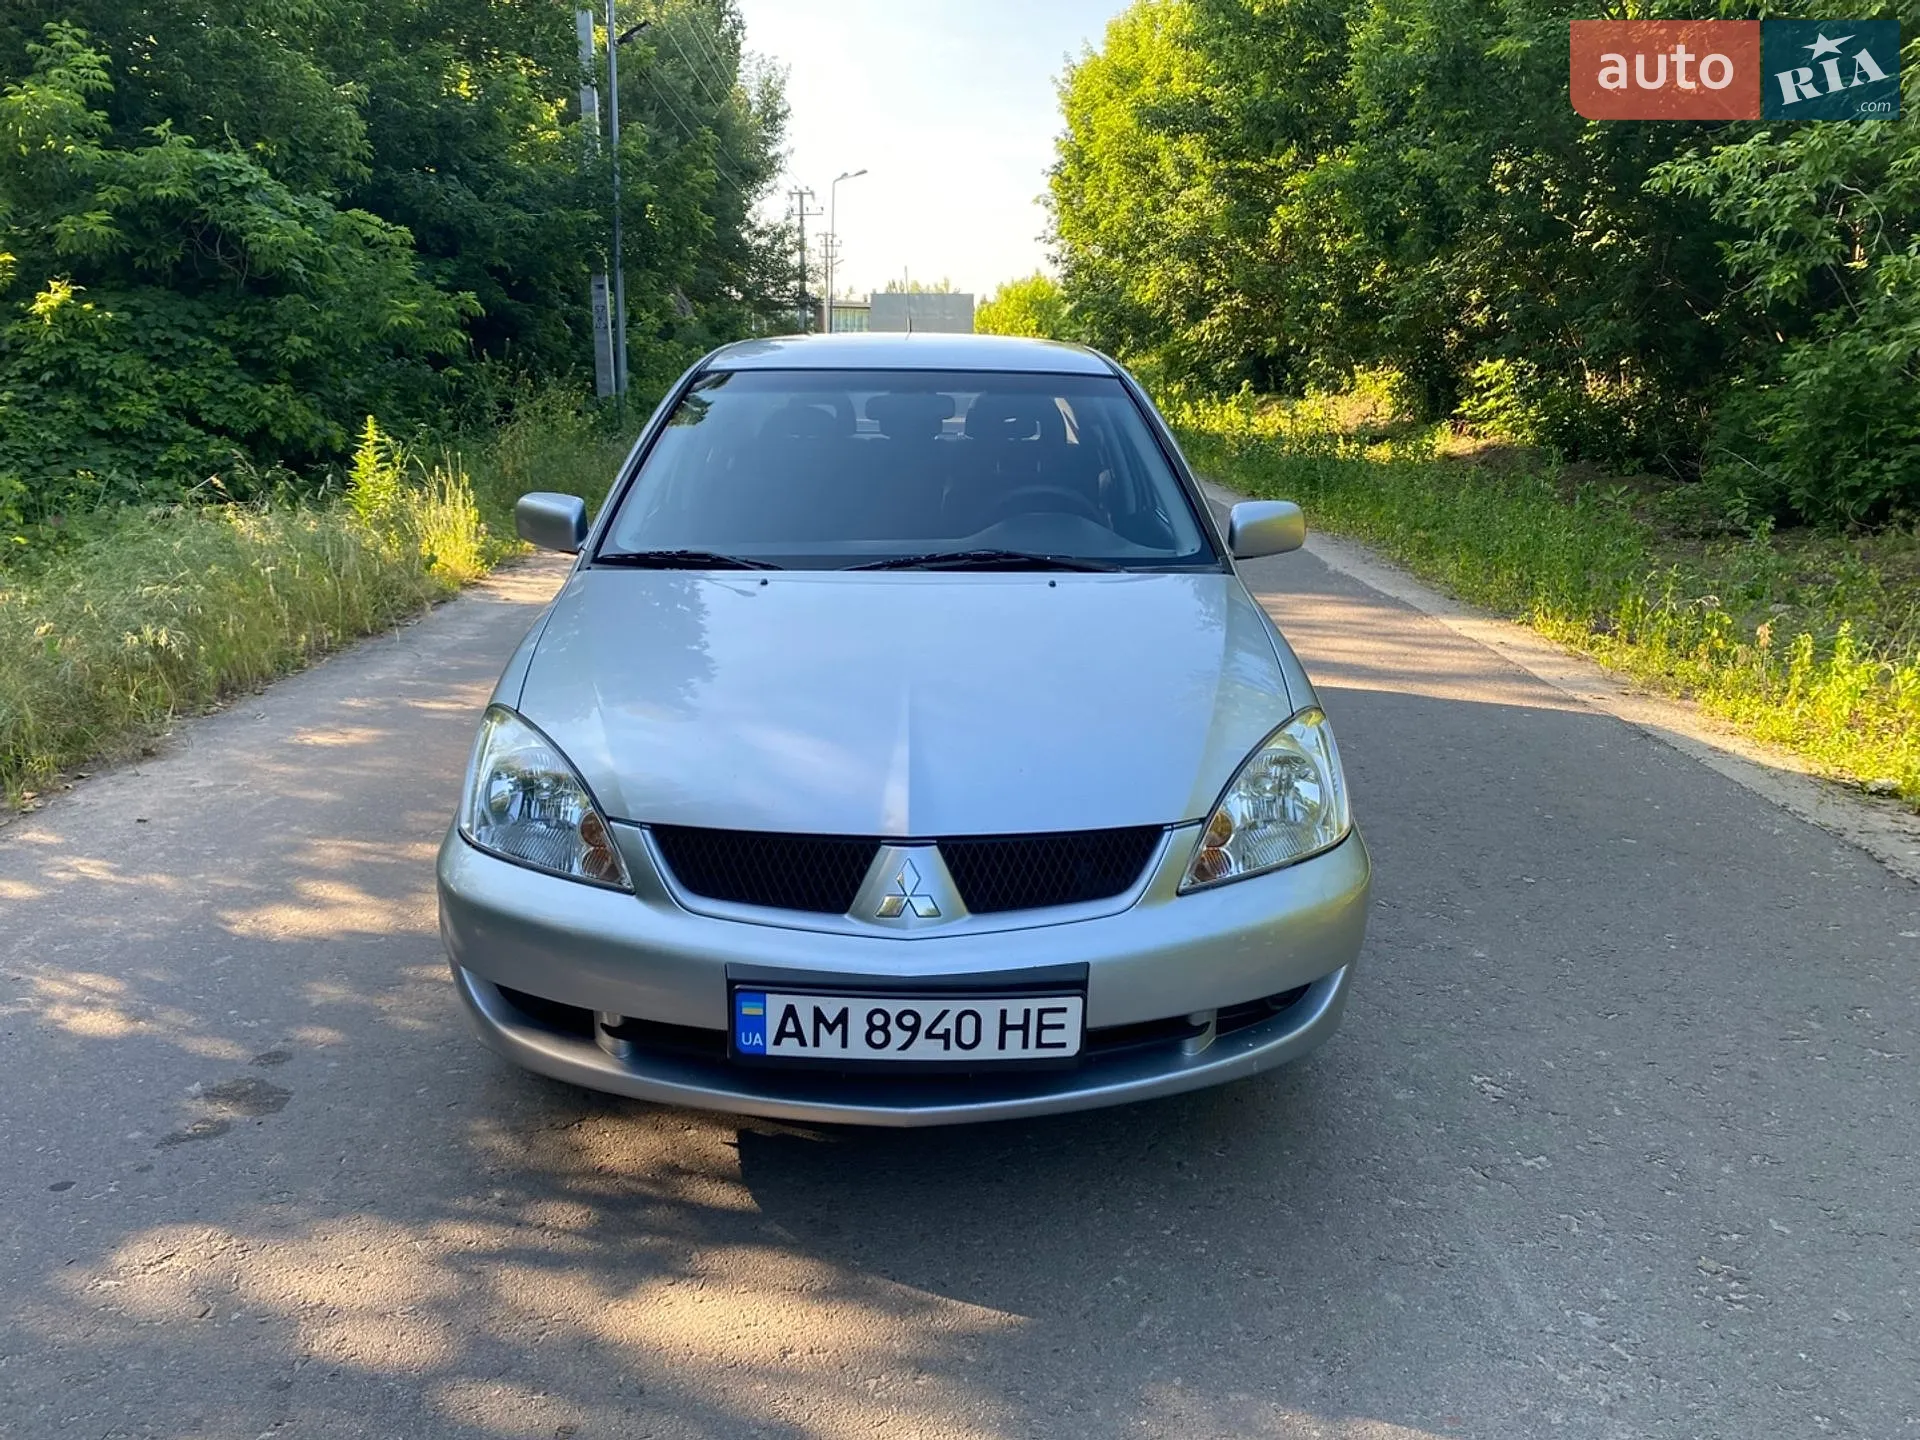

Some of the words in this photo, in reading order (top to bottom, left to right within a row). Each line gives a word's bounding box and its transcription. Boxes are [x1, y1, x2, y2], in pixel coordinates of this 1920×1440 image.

[742, 1033, 763, 1047] UA
[773, 1004, 849, 1049] AM
[865, 1008, 982, 1051] 8940
[997, 1007, 1068, 1050] HE
